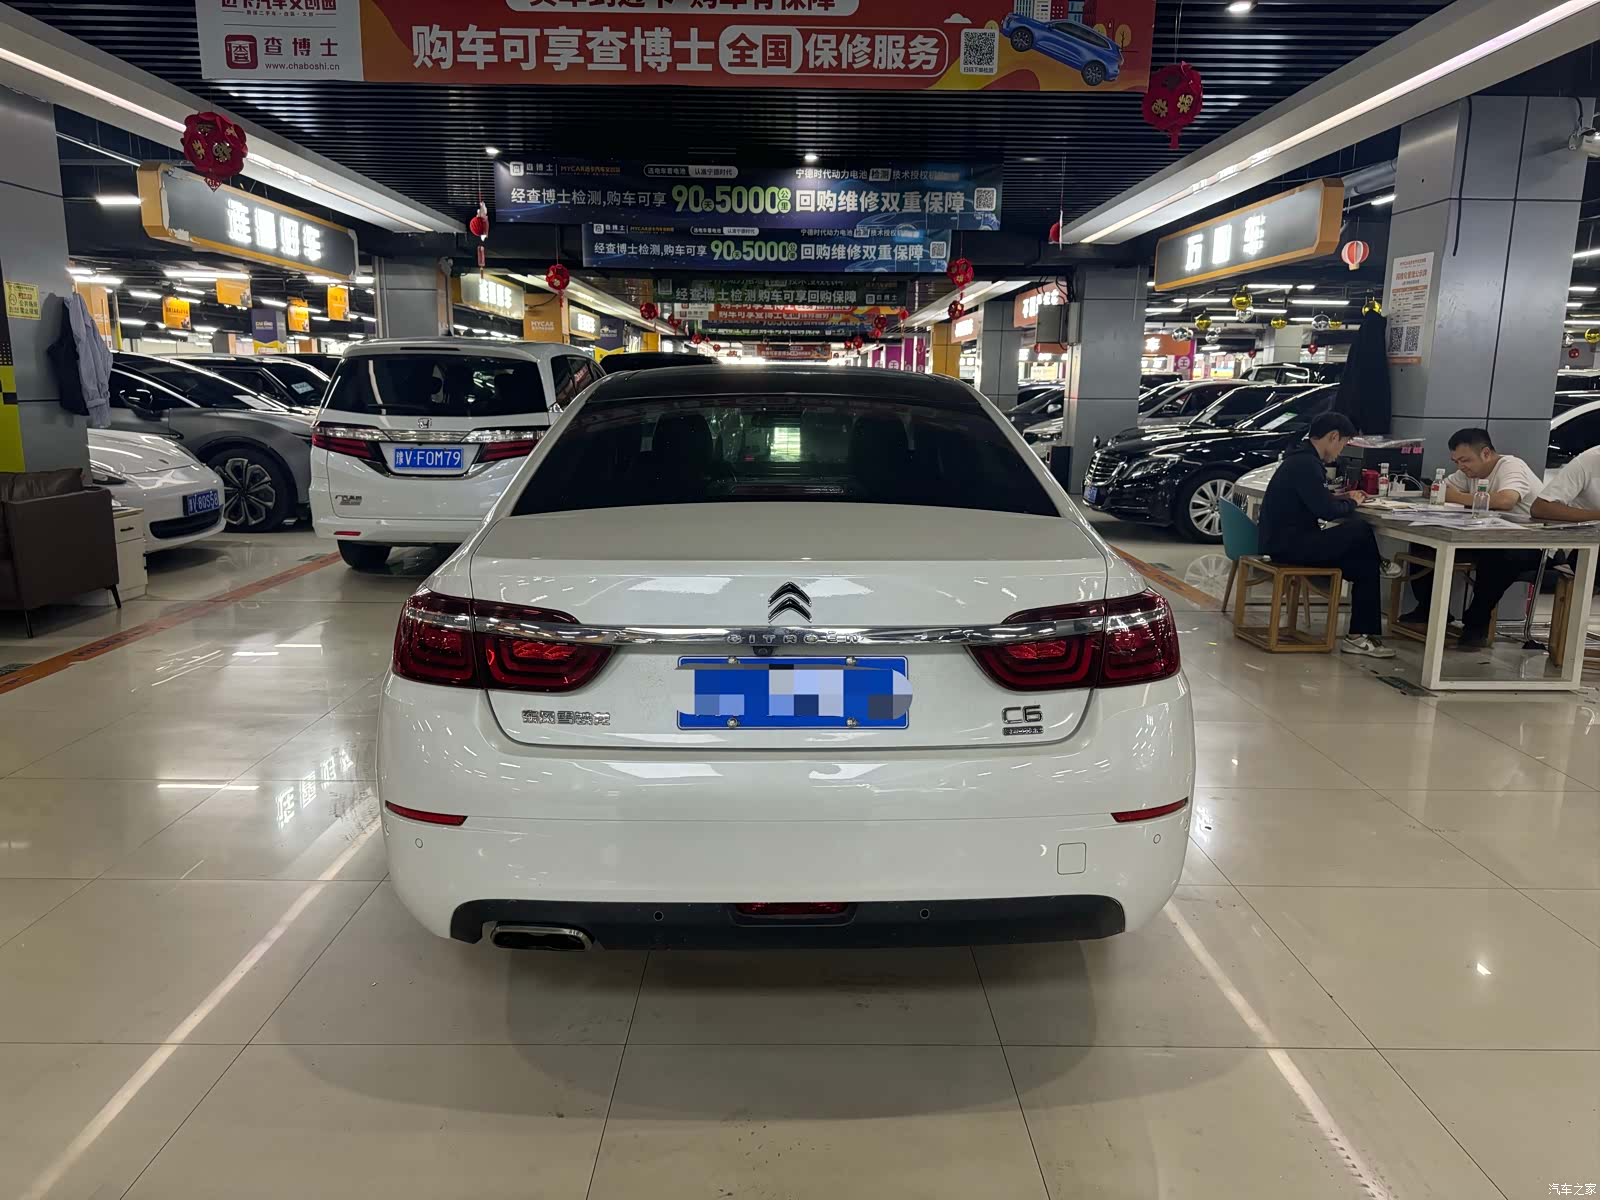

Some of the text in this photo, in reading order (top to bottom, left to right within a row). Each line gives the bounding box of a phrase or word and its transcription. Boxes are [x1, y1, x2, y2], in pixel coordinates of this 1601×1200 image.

[264, 37, 339, 58] 查博士
[412, 24, 941, 73] 购车可享查博士 全国 保修服务
[265, 62, 340, 72] www.chaboshi.cn
[796, 168, 868, 180] 宁德时代动力电池
[511, 187, 667, 208] 经查博士检测,购车可享
[796, 190, 966, 215] 回购维修双重保障
[800, 243, 924, 261] 回购维修双重保障
[1002, 704, 1043, 724] C6
